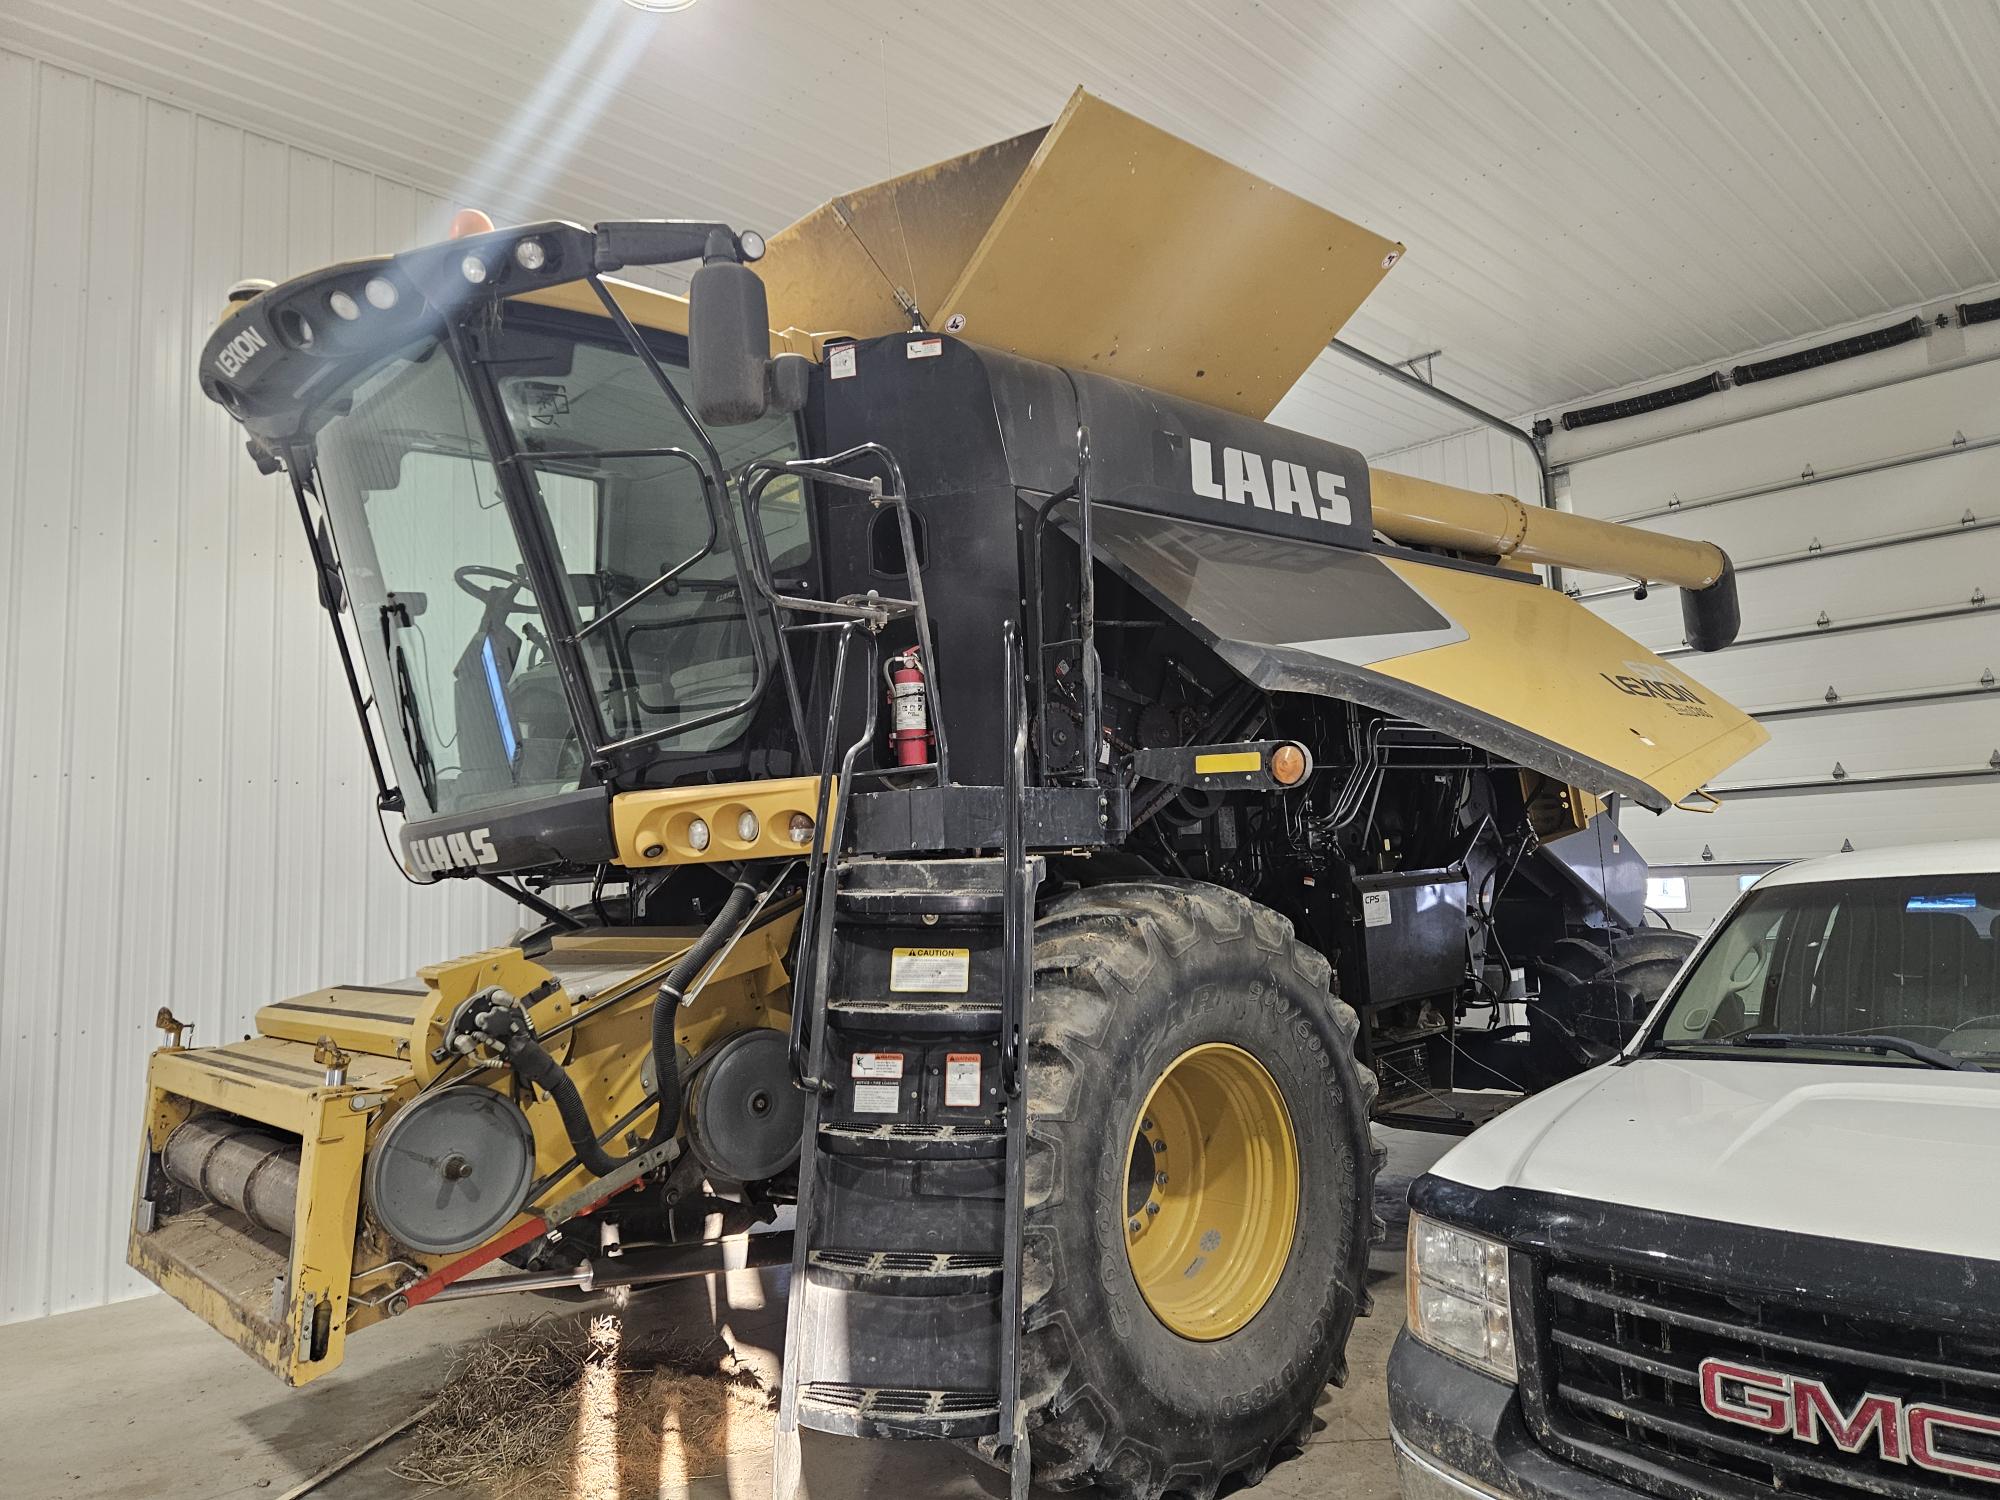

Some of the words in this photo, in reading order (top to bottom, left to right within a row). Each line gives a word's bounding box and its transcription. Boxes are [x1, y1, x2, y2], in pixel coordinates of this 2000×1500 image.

[215, 326, 268, 378] LEXION
[1600, 672, 1706, 704] LEXION
[409, 828, 499, 873] CLAAS
[917, 949, 955, 957] CAUTION
[1698, 1356, 2000, 1484] GMC
